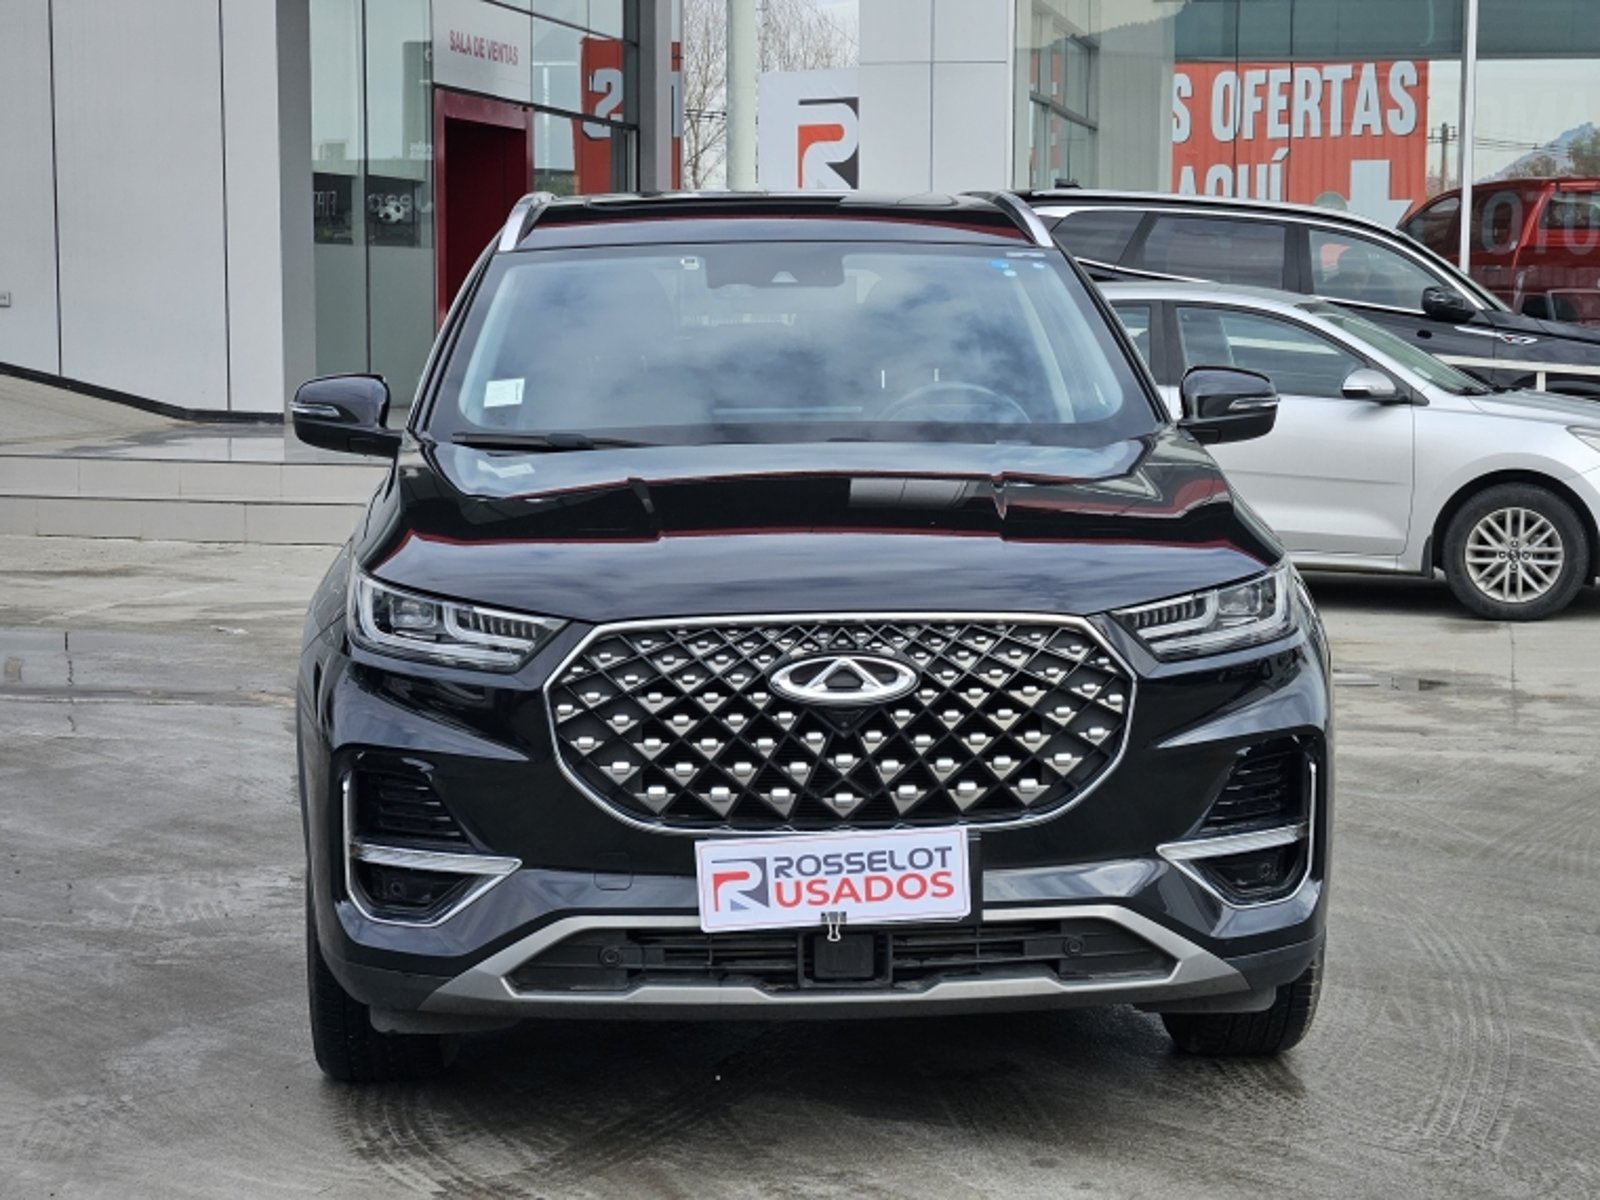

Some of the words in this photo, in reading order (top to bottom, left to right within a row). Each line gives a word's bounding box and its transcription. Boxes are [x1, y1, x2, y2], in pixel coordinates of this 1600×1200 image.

[449, 29, 472, 55] SALA
[473, 35, 485, 59] DE
[486, 39, 519, 67] VENTAS
[1210, 60, 1419, 142] OFERTAS
[774, 846, 953, 878] ROSSELOT
[774, 871, 955, 908] USADOS
